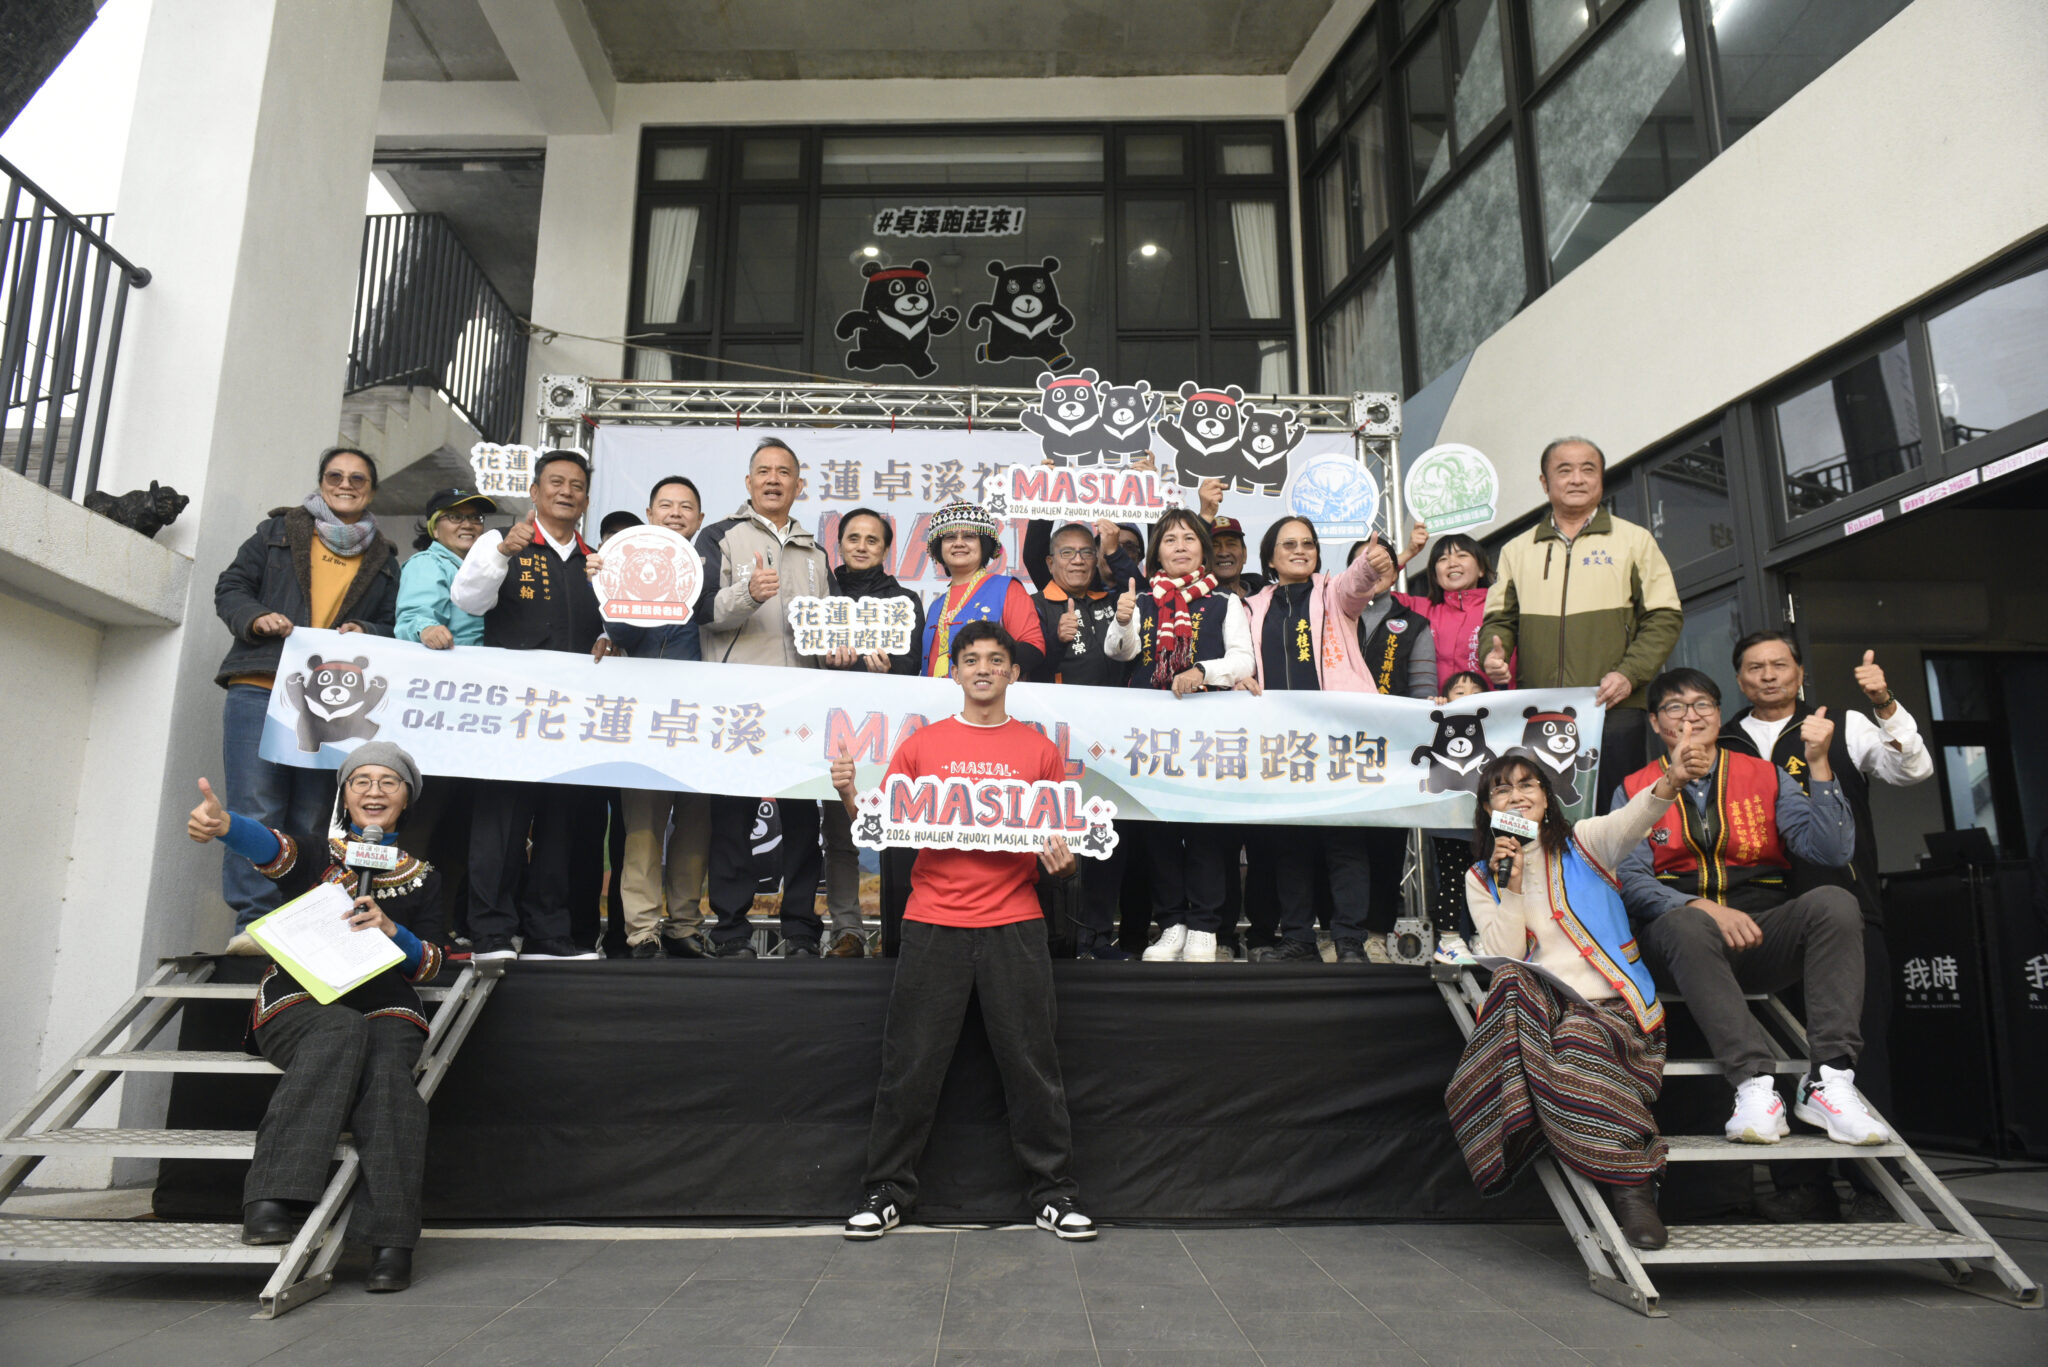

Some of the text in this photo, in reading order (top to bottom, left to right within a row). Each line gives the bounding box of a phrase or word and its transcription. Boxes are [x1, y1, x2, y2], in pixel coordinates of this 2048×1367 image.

[876, 208, 1023, 234] #卓溪跑起來!
[1012, 468, 1164, 507] MASIAL
[1009, 504, 1161, 519] 2026 HUALIEN ZHUOXI MASIAL ROAD RUN
[793, 601, 912, 626] 花蓮卓溪
[800, 627, 905, 650] 祝福路跑
[406, 677, 509, 707] 2026
[401, 707, 503, 736] 04.25
[509, 686, 771, 756] 花蓮卓溪
[1122, 726, 1388, 783] 祝福路跑
[950, 760, 1012, 777] MASIAL
[889, 780, 1088, 831] MASIAL
[886, 828, 911, 841] 2026
[914, 830, 954, 843] HUALIEN
[956, 832, 991, 845] ZHUOXI
[994, 833, 1029, 846] MASIAL
[1500, 818, 1530, 831] MASIAL
[355, 850, 390, 861] MASIAL
[1903, 955, 1959, 991] 我時
